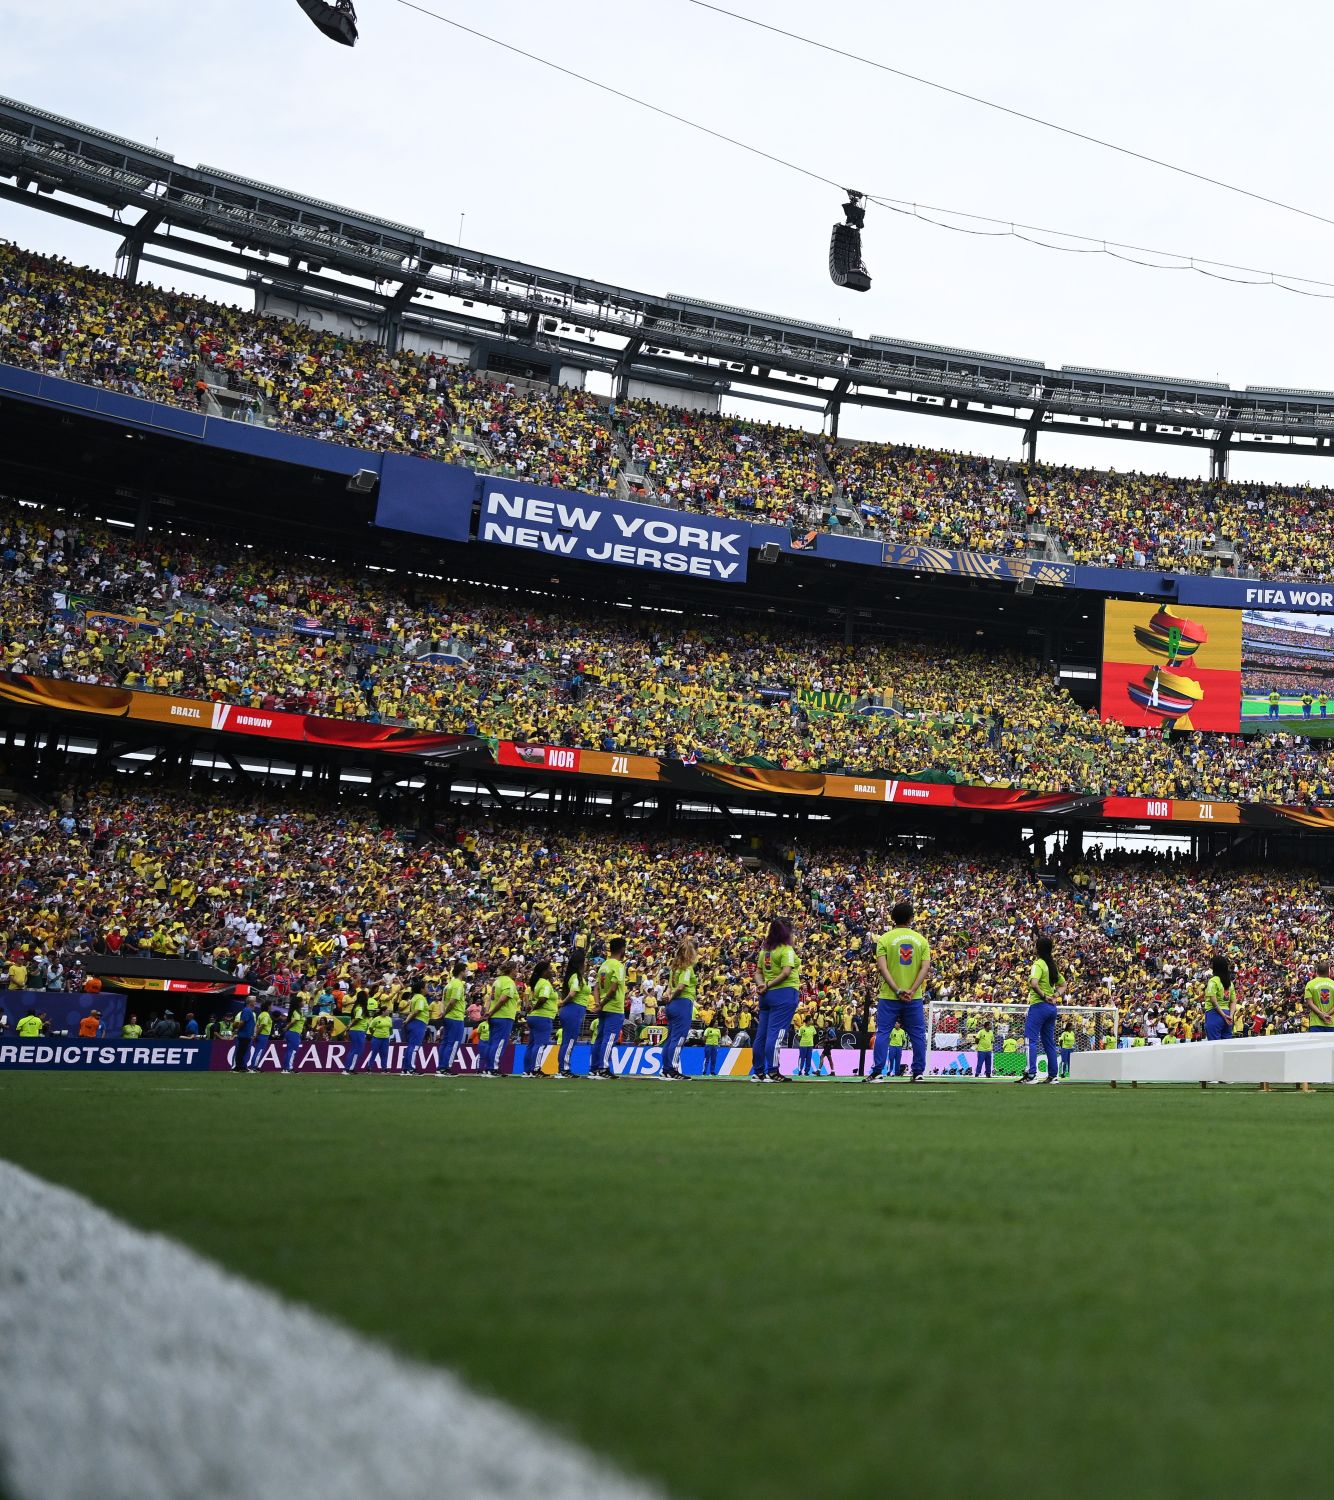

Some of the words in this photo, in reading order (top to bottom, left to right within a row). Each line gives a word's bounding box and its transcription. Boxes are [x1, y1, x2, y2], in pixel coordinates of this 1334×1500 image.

[487, 492, 601, 531] NEW
[612, 514, 741, 555] YORK
[484, 522, 578, 554] NEW
[586, 543, 739, 579] JERSEY
[1246, 588, 1287, 605] FIFA
[170, 705, 201, 719] BRAZIL
[211, 702, 232, 731] V
[236, 715, 273, 729] NORWAY
[548, 749, 575, 768] NOR
[611, 756, 629, 774] ZIL
[854, 784, 877, 794] BRAZIL
[884, 779, 899, 802] V
[902, 788, 930, 798] NORWAY
[1146, 801, 1168, 817] NOR
[1199, 803, 1214, 819] ZIL
[0, 1046, 199, 1065] REDICTSTREET
